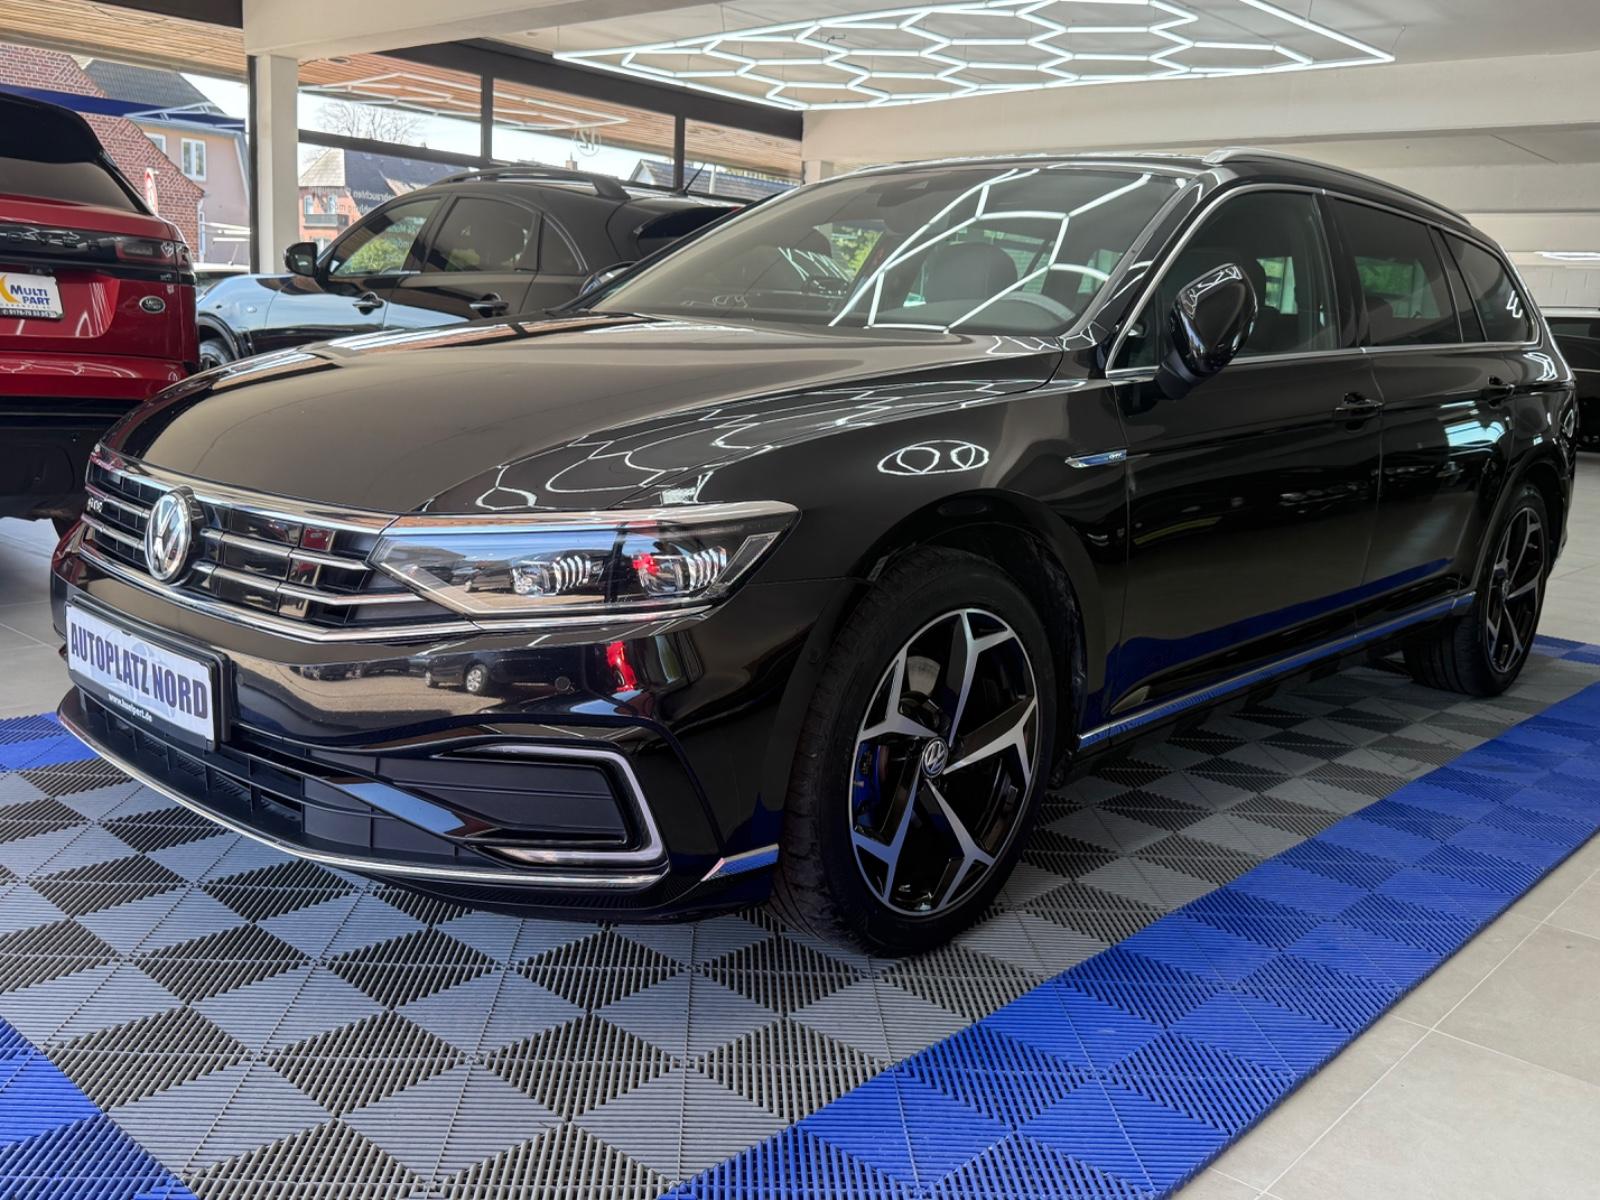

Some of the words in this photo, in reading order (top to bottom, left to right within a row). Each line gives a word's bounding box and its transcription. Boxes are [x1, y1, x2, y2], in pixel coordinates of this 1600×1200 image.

[10, 284, 48, 297] MULTI
[22, 296, 50, 305] PART
[71, 622, 150, 695] AUTOPLATZ
[152, 662, 208, 720] NORD
